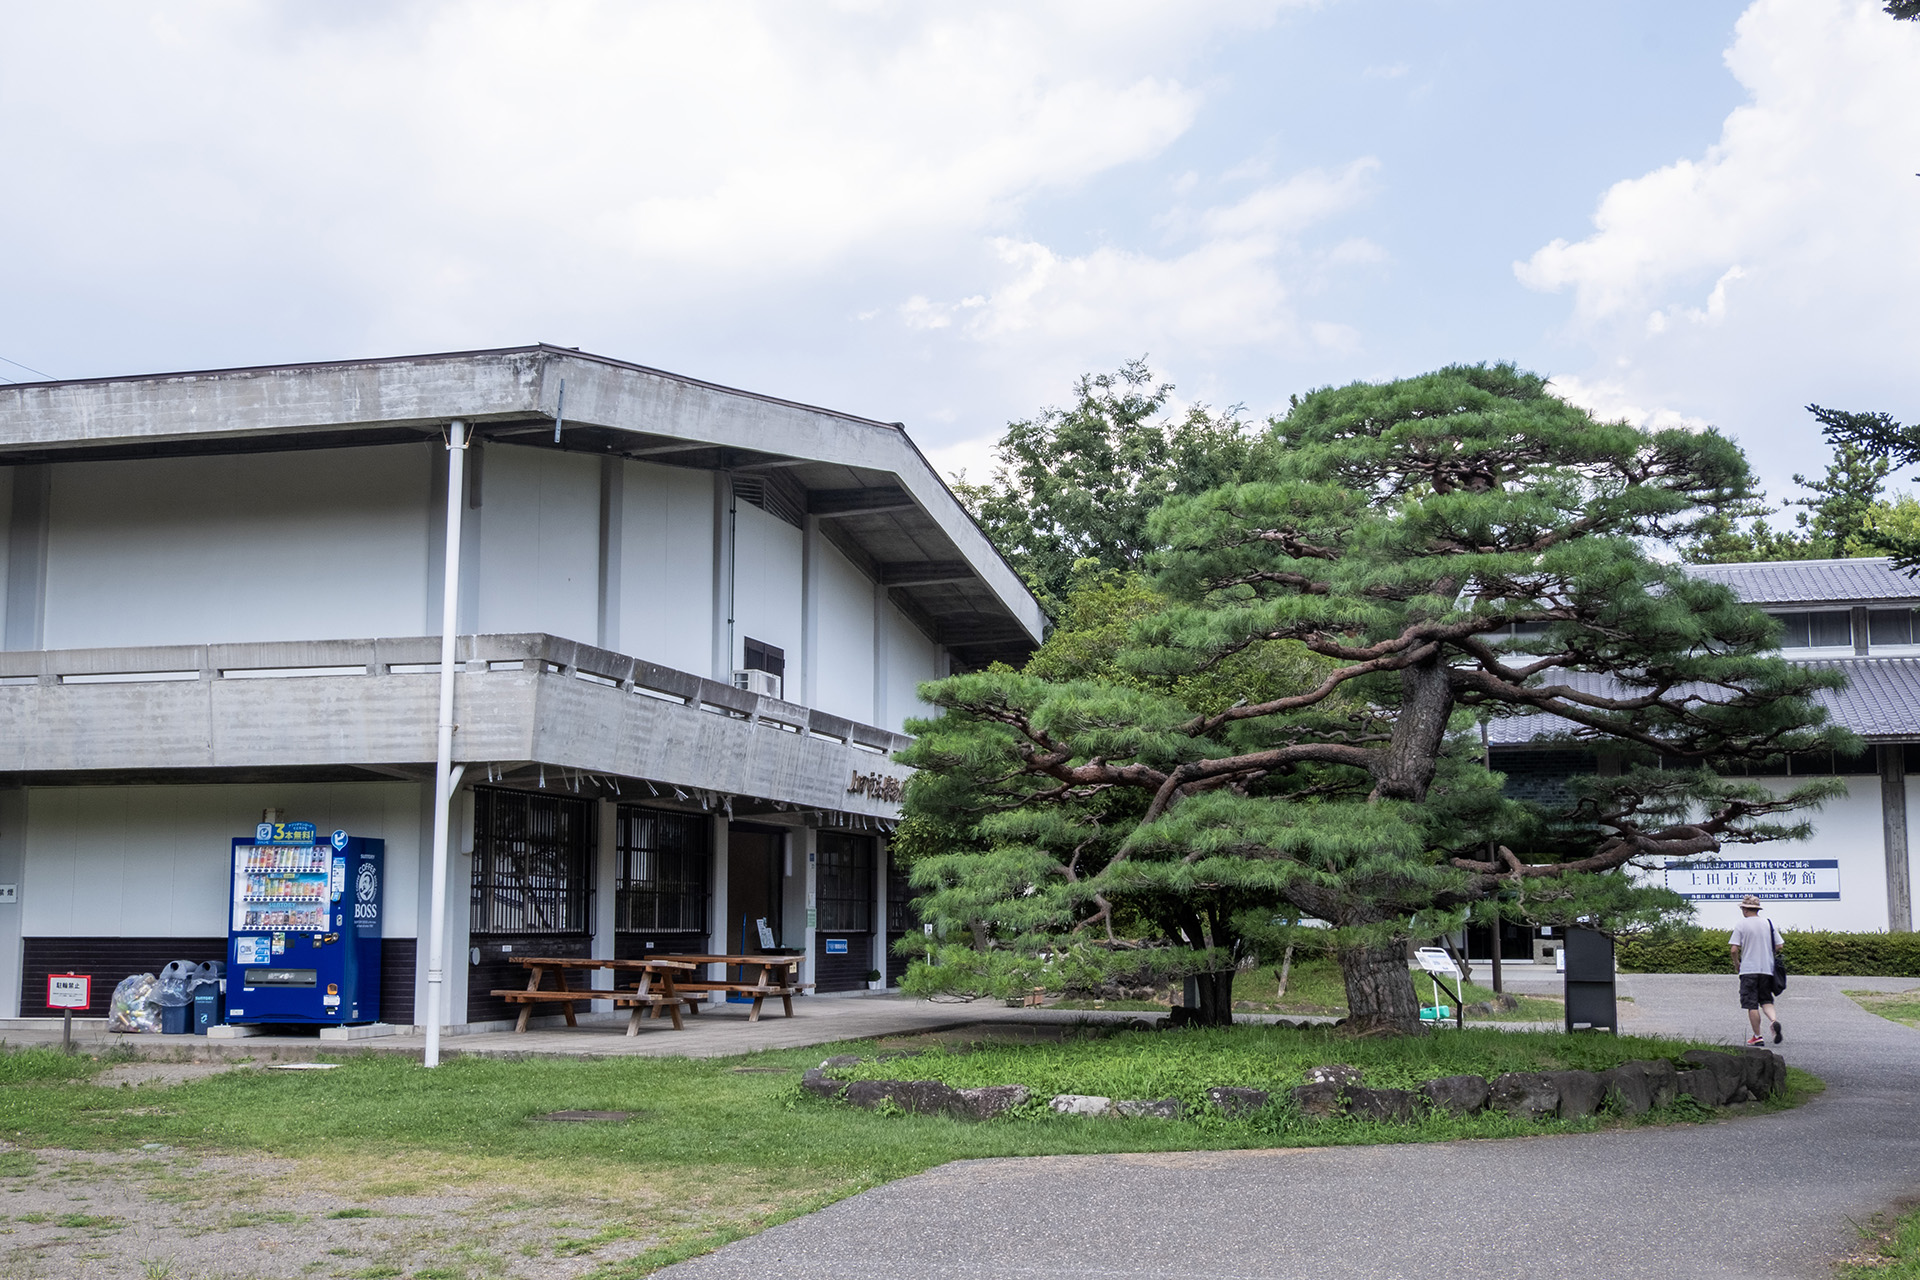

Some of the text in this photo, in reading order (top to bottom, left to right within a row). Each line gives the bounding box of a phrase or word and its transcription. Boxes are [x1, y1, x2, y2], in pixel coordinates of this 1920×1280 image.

[358, 863, 377, 874] COFFEE
[1688, 871, 1816, 885] 上田市立博物館
[354, 903, 378, 918] BOSS
